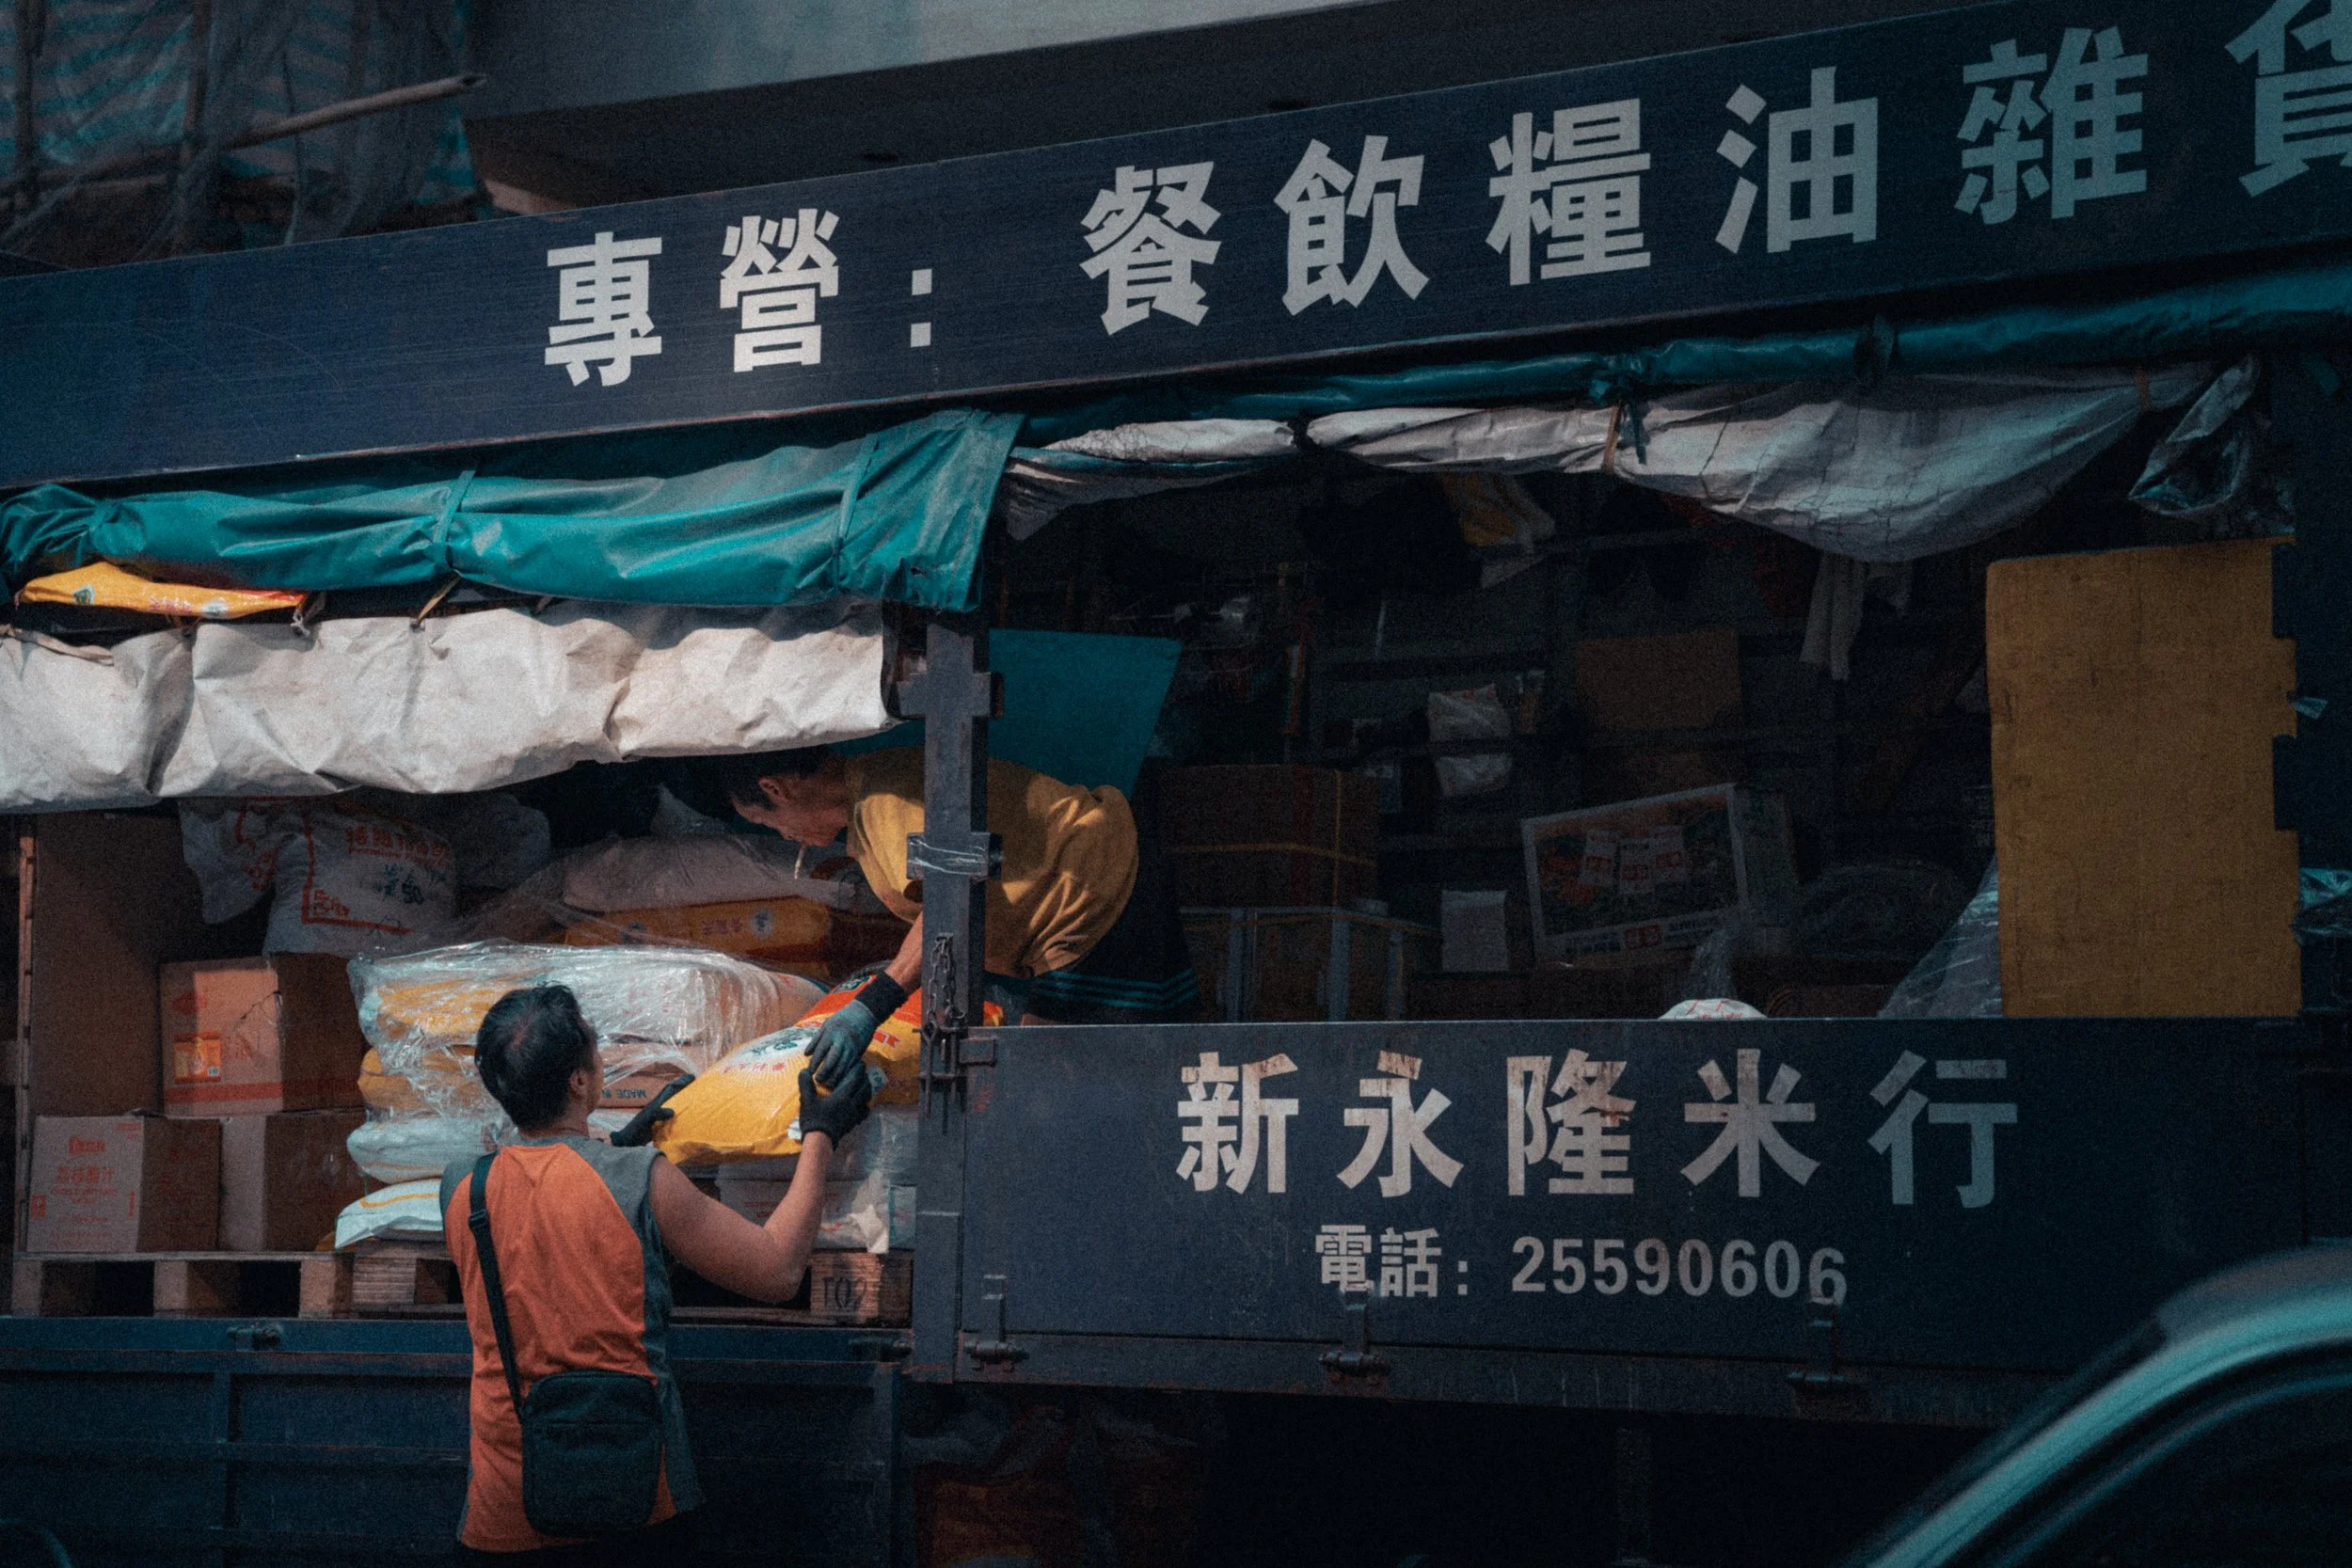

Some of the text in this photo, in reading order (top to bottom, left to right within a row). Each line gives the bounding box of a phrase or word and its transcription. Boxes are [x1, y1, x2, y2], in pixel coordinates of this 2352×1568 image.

[1176, 1048, 2017, 1209] 新永隆米行
[1315, 1224, 1847, 1305] 電話： 25590606
